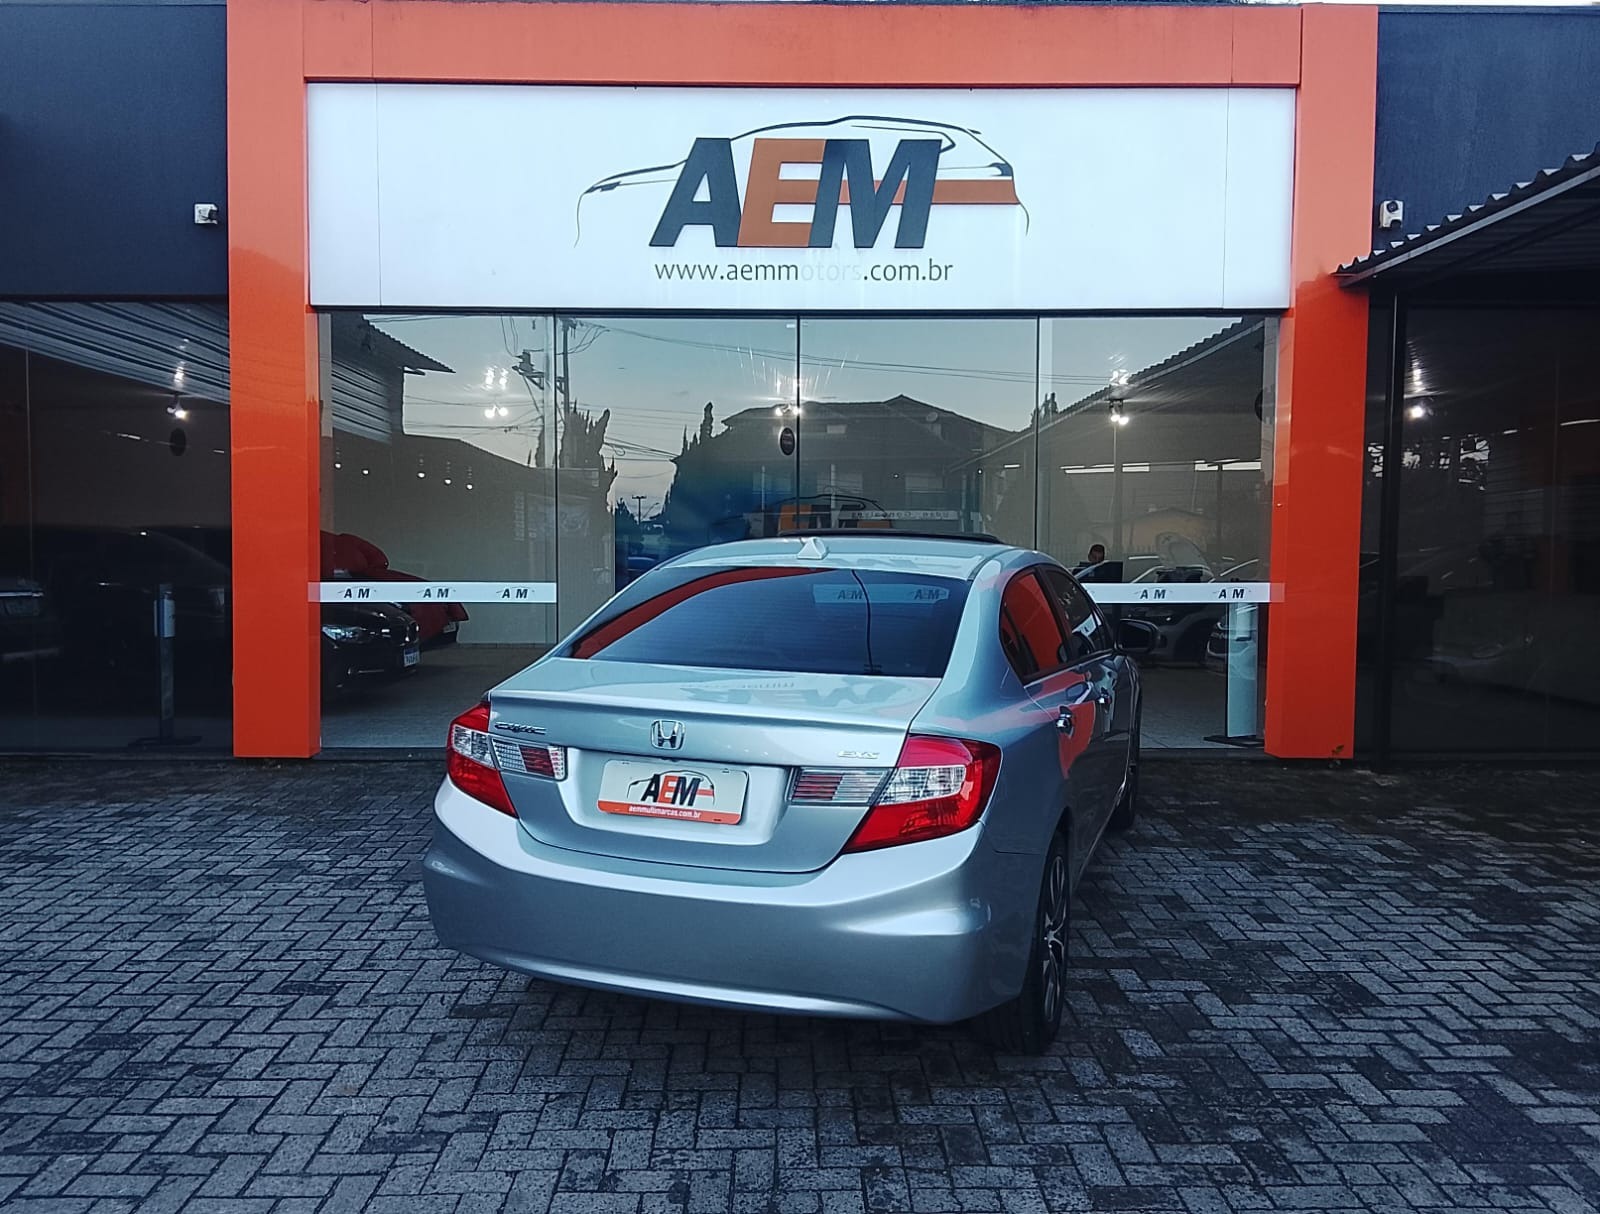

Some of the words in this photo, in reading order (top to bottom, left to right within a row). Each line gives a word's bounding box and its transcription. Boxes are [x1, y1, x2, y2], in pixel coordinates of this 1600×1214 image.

[649, 138, 942, 249] AEM
[655, 258, 953, 282] www.aemmotors.com.br
[640, 774, 702, 807] AEM
[628, 805, 702, 819] aemmultimarcas.com.br
